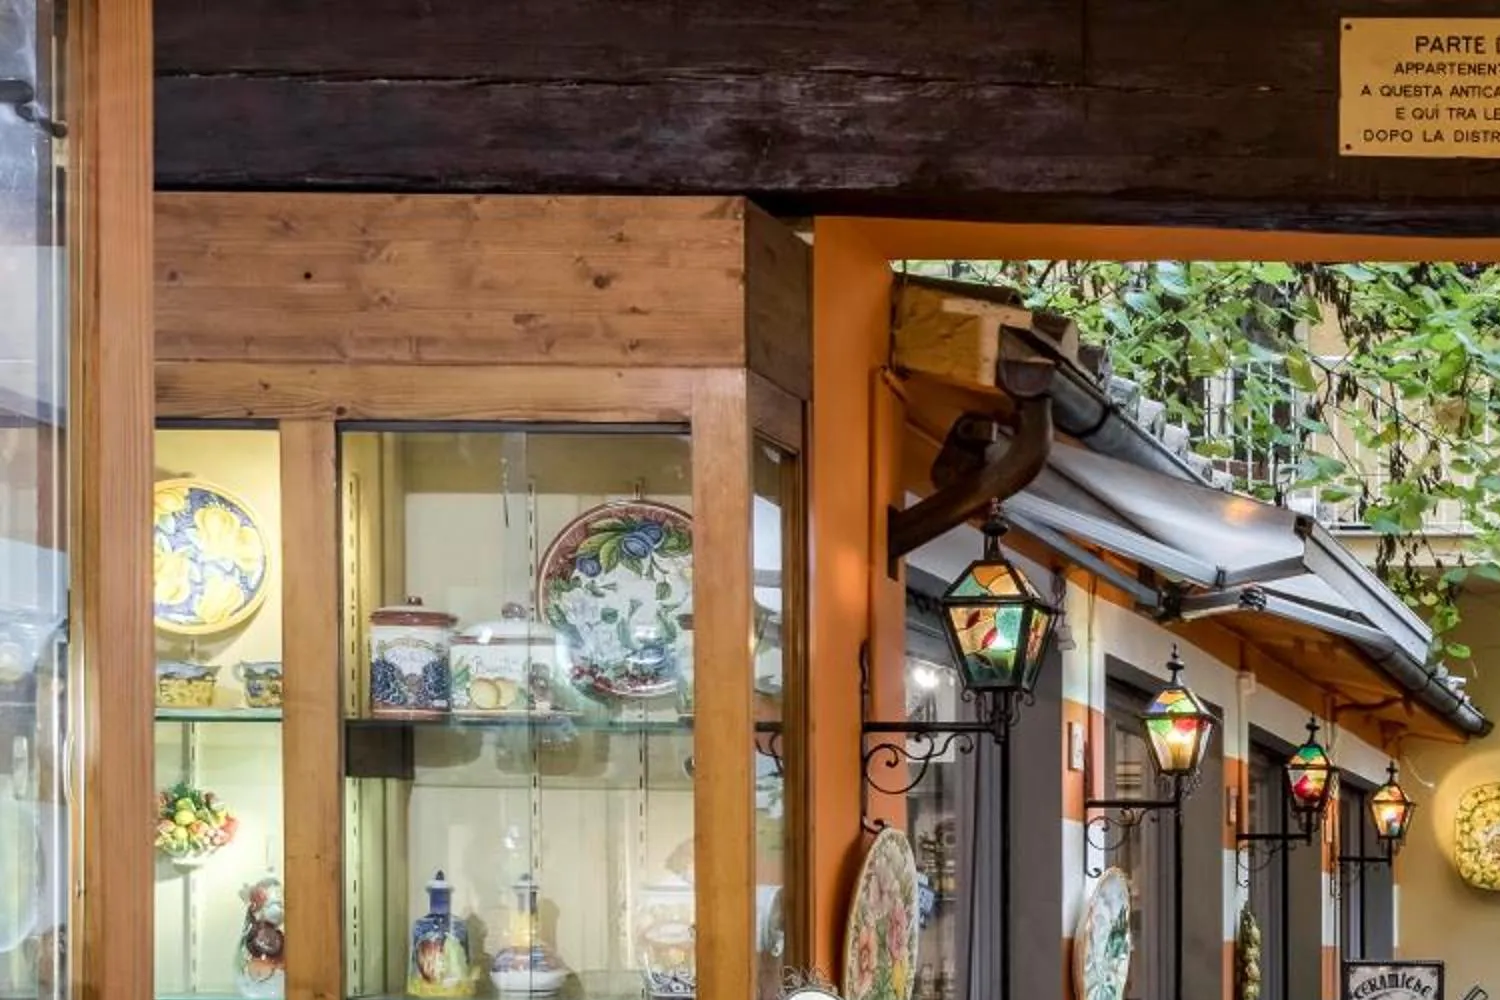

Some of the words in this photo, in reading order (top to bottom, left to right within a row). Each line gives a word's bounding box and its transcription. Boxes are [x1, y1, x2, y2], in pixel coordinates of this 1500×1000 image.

[1415, 35, 1486, 54] PARTE
[1360, 85, 1372, 97] A
[1379, 85, 1443, 98] QUESTA
[1395, 107, 1406, 120] E
[1447, 107, 1477, 121] TRA
[1363, 130, 1413, 143] DOPO
[1422, 130, 1445, 143] LA
